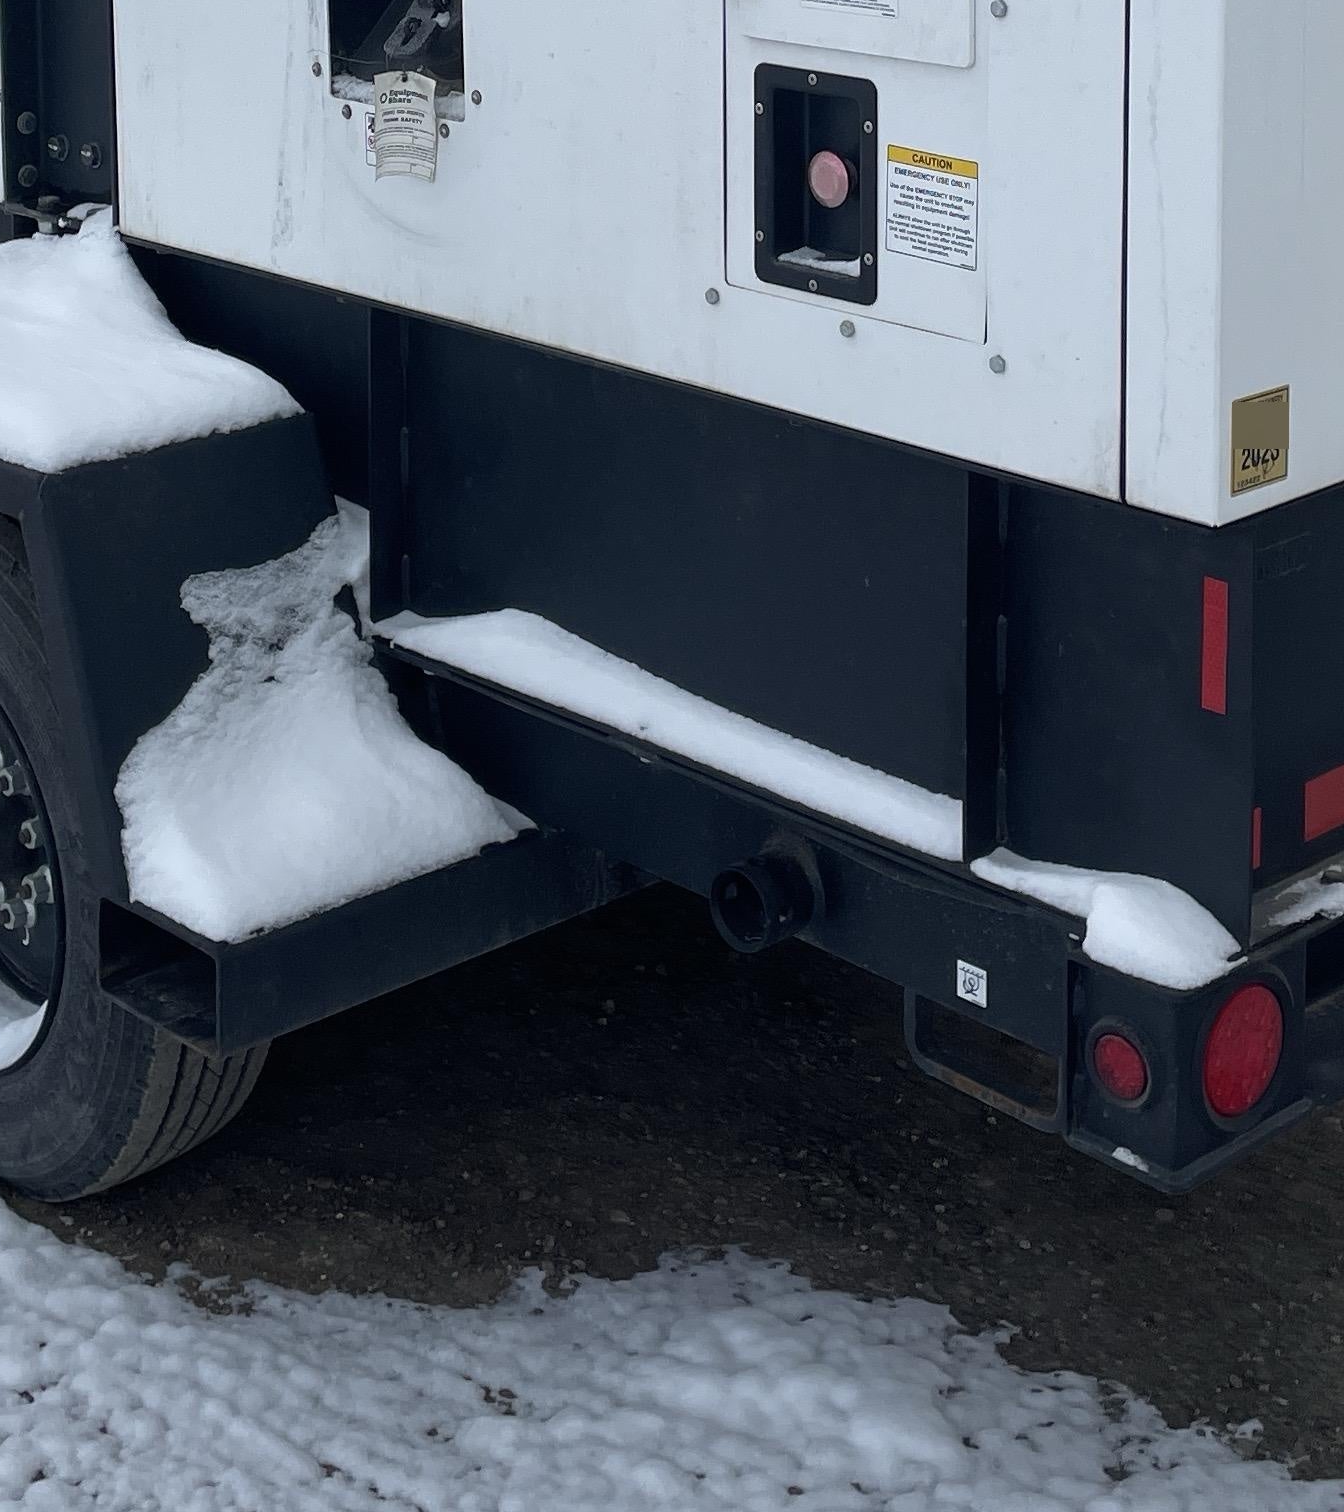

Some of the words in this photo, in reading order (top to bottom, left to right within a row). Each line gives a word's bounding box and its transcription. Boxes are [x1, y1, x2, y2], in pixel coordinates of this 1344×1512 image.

[912, 154, 952, 170] CAUTION
[894, 167, 935, 182] EMERGENCY
[936, 176, 950, 186] USE
